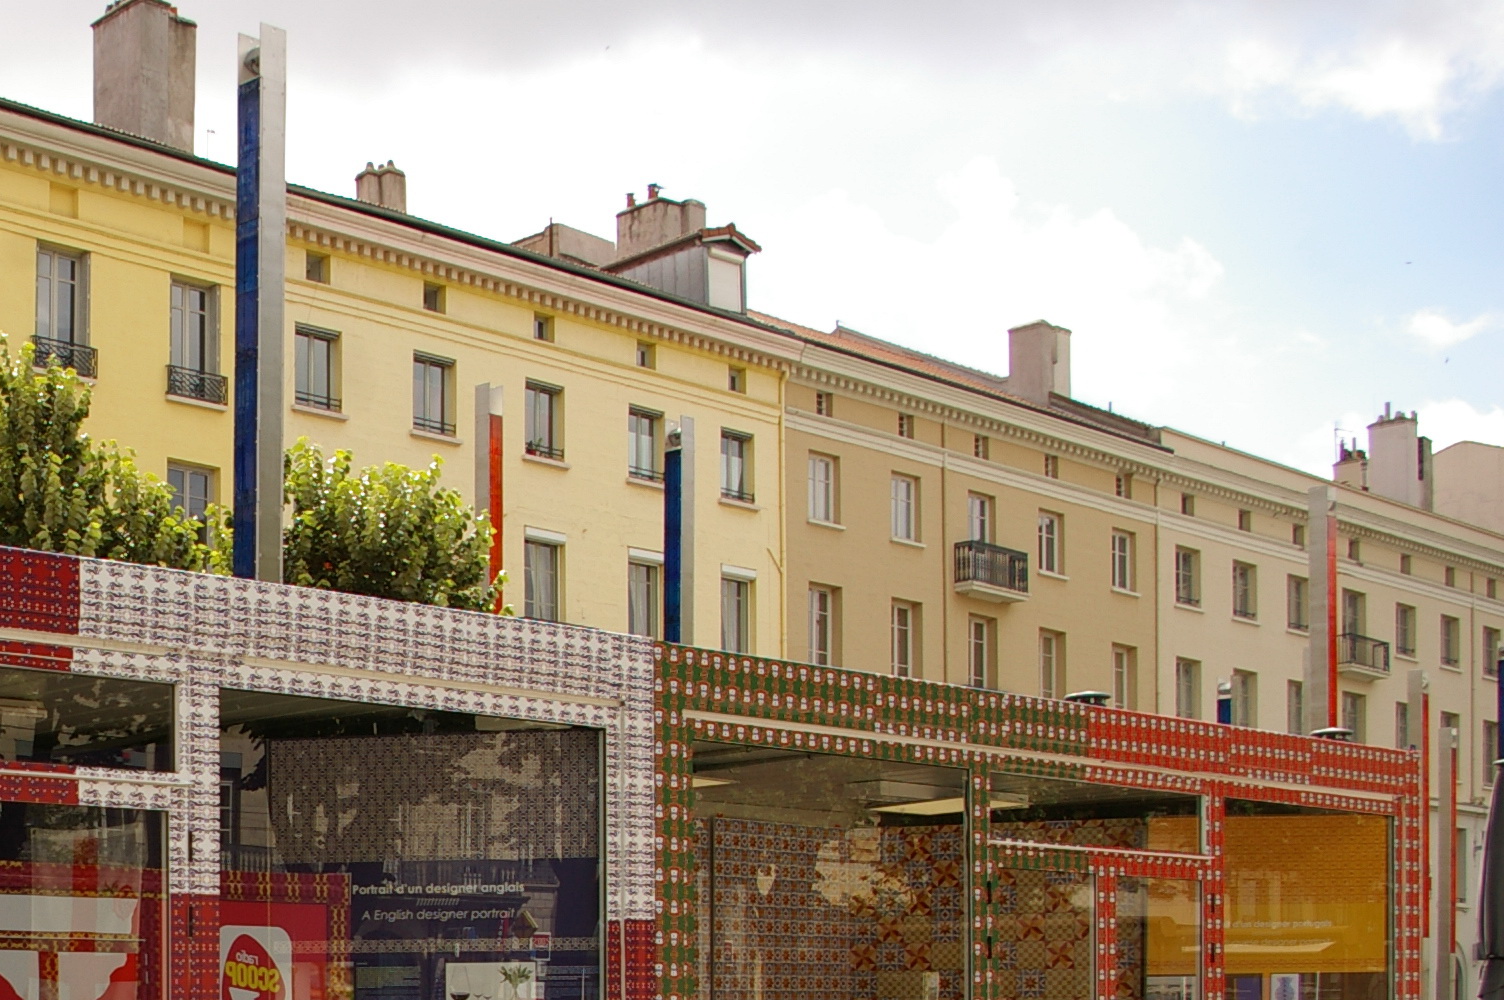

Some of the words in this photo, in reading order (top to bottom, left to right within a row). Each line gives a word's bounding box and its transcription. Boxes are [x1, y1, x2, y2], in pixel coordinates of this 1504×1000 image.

[352, 884, 393, 895] Portrait
[395, 883, 422, 894] d'un
[425, 883, 476, 896] designer
[481, 881, 525, 895] anglais
[361, 911, 371, 920] A
[374, 909, 413, 922] English
[416, 908, 467, 921] designer
[470, 907, 516, 921] portrait
